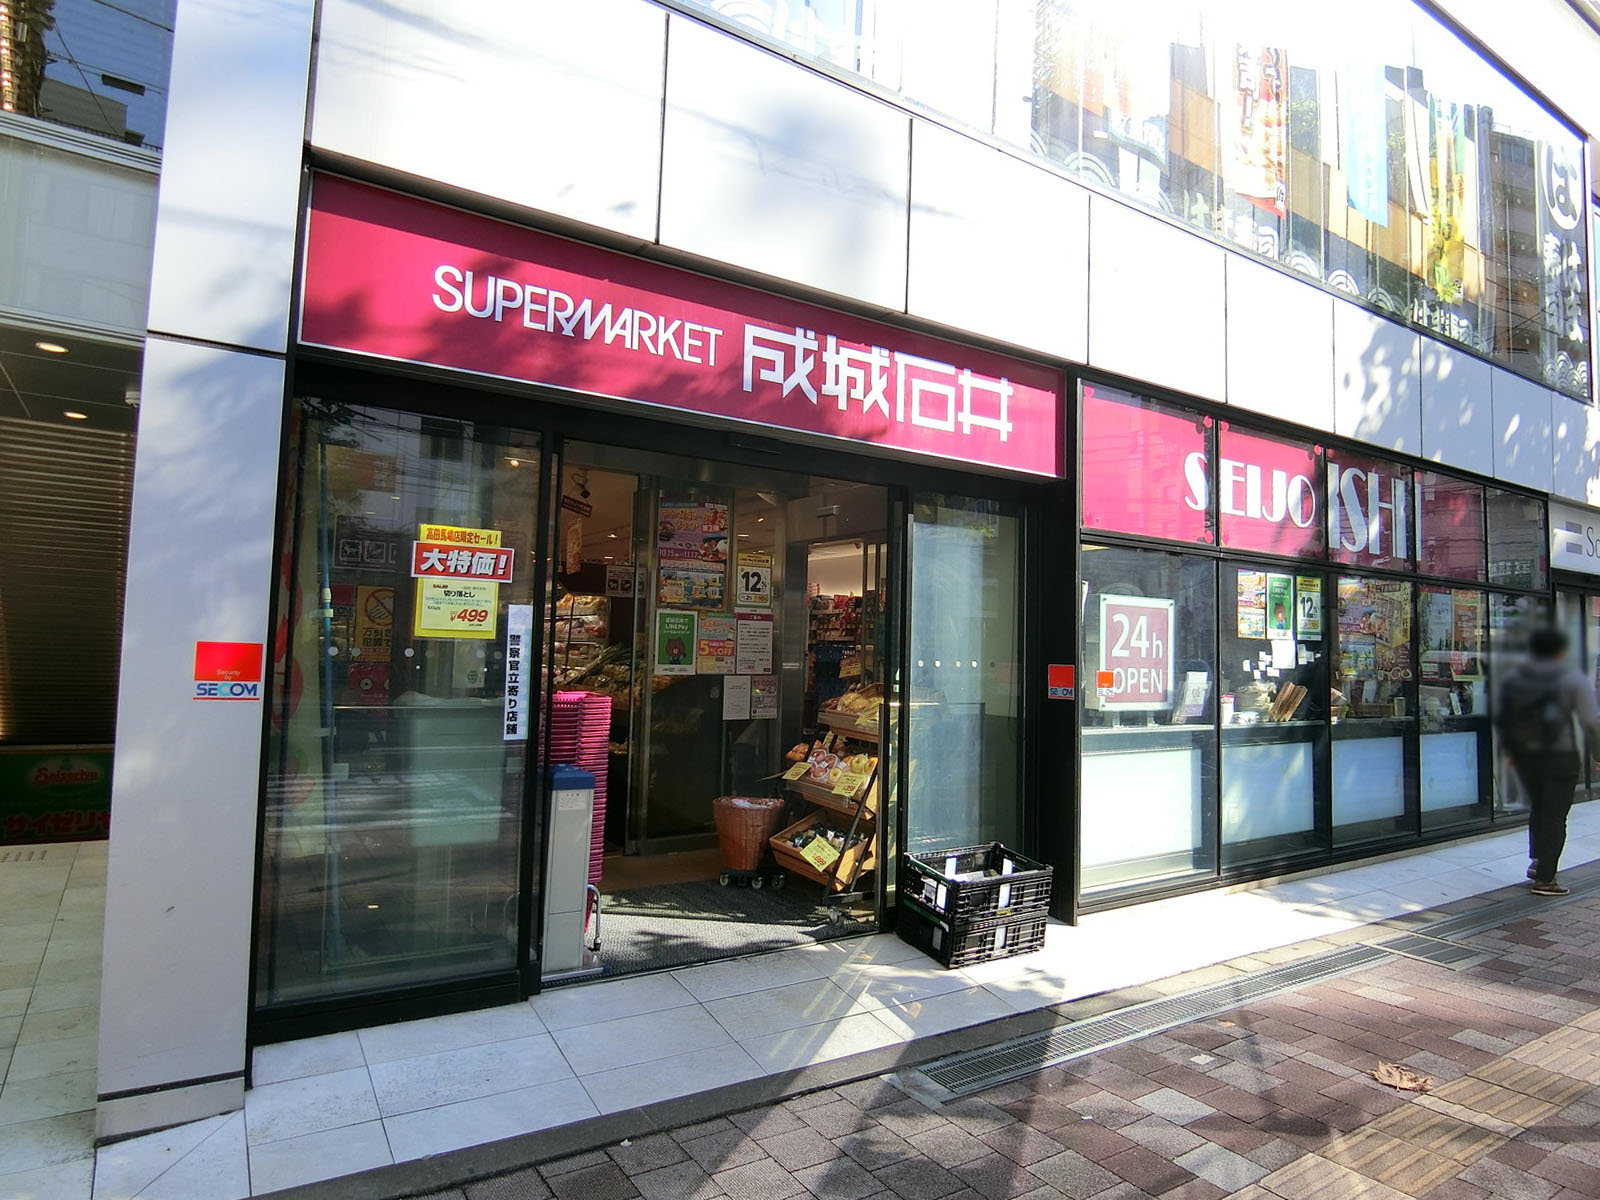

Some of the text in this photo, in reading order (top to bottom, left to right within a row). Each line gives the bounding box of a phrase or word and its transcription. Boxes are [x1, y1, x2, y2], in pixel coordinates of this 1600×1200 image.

[432, 265, 1013, 442] SUPERMARKET 成城石井
[1184, 451, 1422, 562] SEIJO ISHII
[420, 548, 508, 576] 大特価!
[444, 590, 475, 598] 切り落とし
[196, 682, 259, 697] SECOM
[505, 634, 521, 735] 警察官立寄り店舗
[1097, 688, 1114, 697] SEOM
[1112, 667, 1164, 694] OPEN
